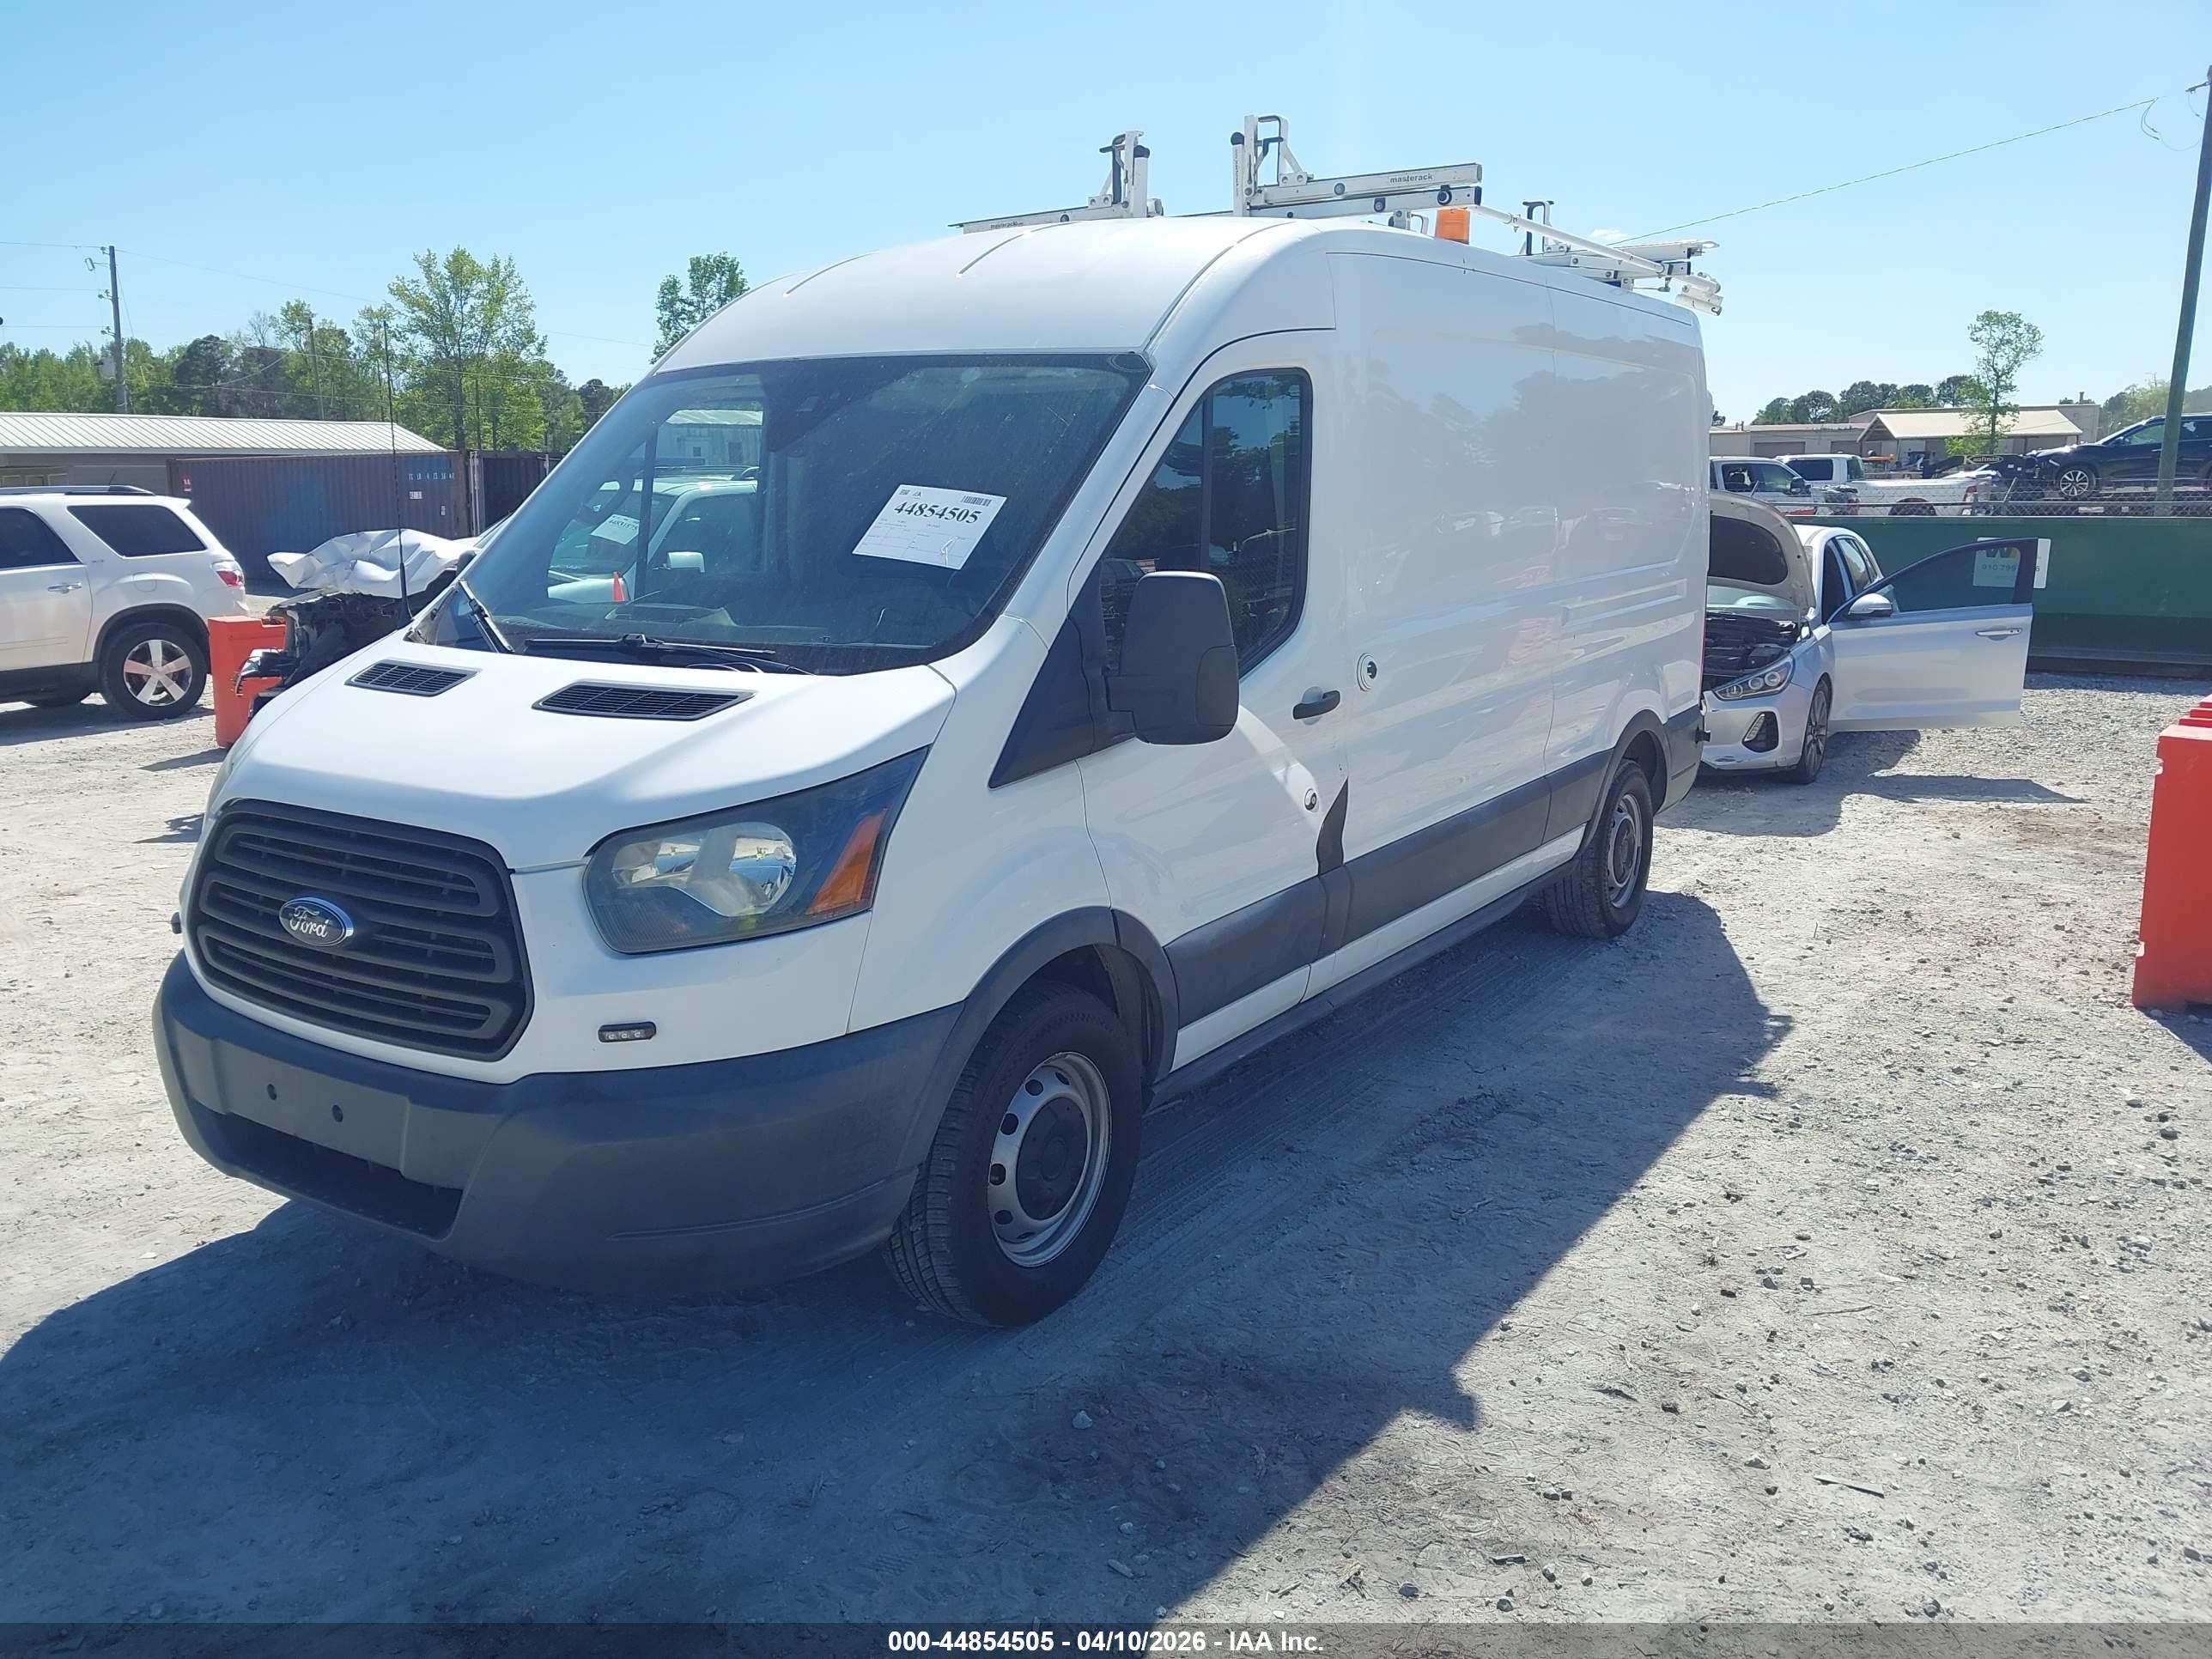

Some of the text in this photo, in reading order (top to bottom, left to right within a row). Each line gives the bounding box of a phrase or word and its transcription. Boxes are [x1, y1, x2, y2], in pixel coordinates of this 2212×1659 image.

[1389, 173, 1434, 184] masterack
[1964, 455, 2001, 465] Kaufman
[894, 501, 982, 524] 44854505
[289, 906, 330, 938] Ford
